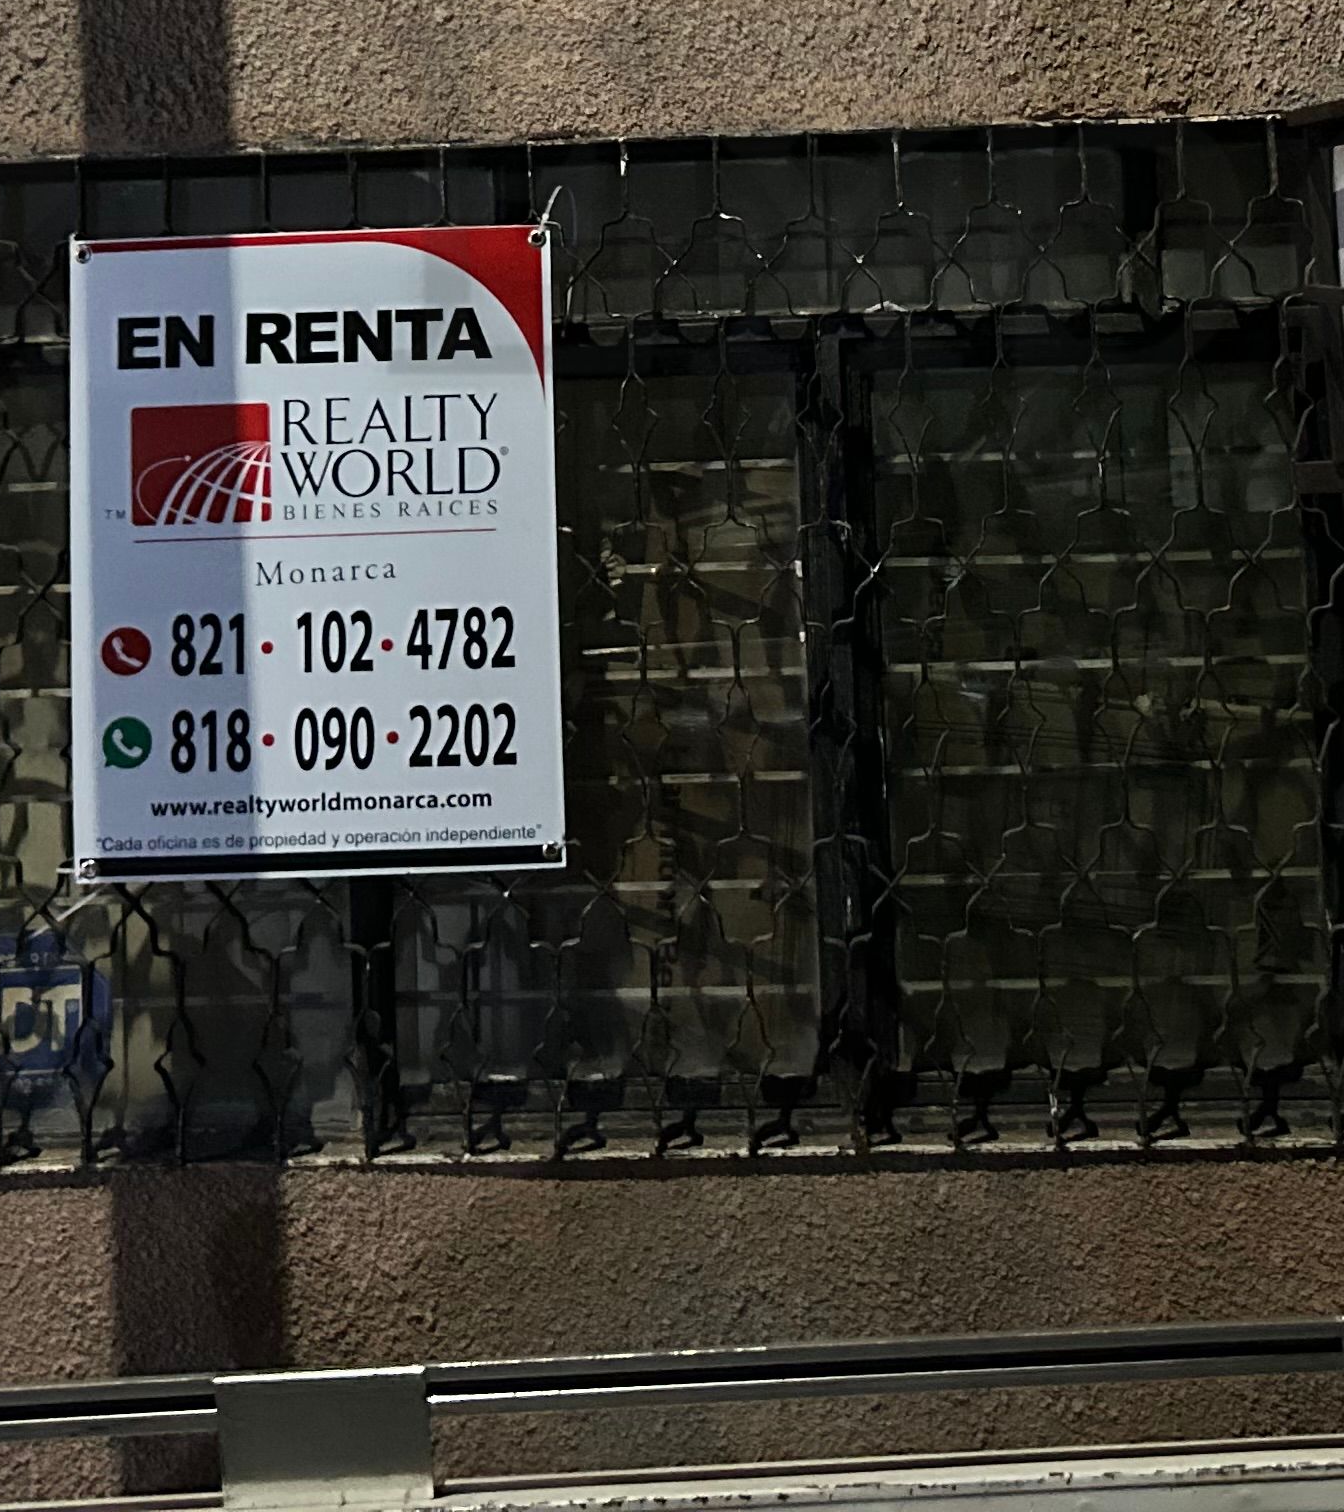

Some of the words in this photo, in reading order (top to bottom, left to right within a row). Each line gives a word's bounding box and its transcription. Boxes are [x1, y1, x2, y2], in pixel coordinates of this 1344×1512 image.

[117, 315, 215, 370] EN
[245, 307, 493, 365] RENTA
[283, 392, 498, 446] REALTY
[283, 502, 382, 521] BIENES
[398, 498, 499, 518] RAICES
[256, 561, 397, 587] Monarca
[170, 612, 246, 677] 821
[296, 609, 374, 674] 102
[406, 605, 517, 671] 4782
[170, 708, 252, 774] 818
[294, 706, 376, 772] 090
[408, 702, 518, 768] 2202
[150, 791, 493, 819] www.realtyworldmonarca.com
[148, 835, 196, 850] oficina
[202, 838, 221, 848] es
[225, 834, 244, 847] de
[249, 831, 326, 851] propiedad
[331, 834, 340, 848] y
